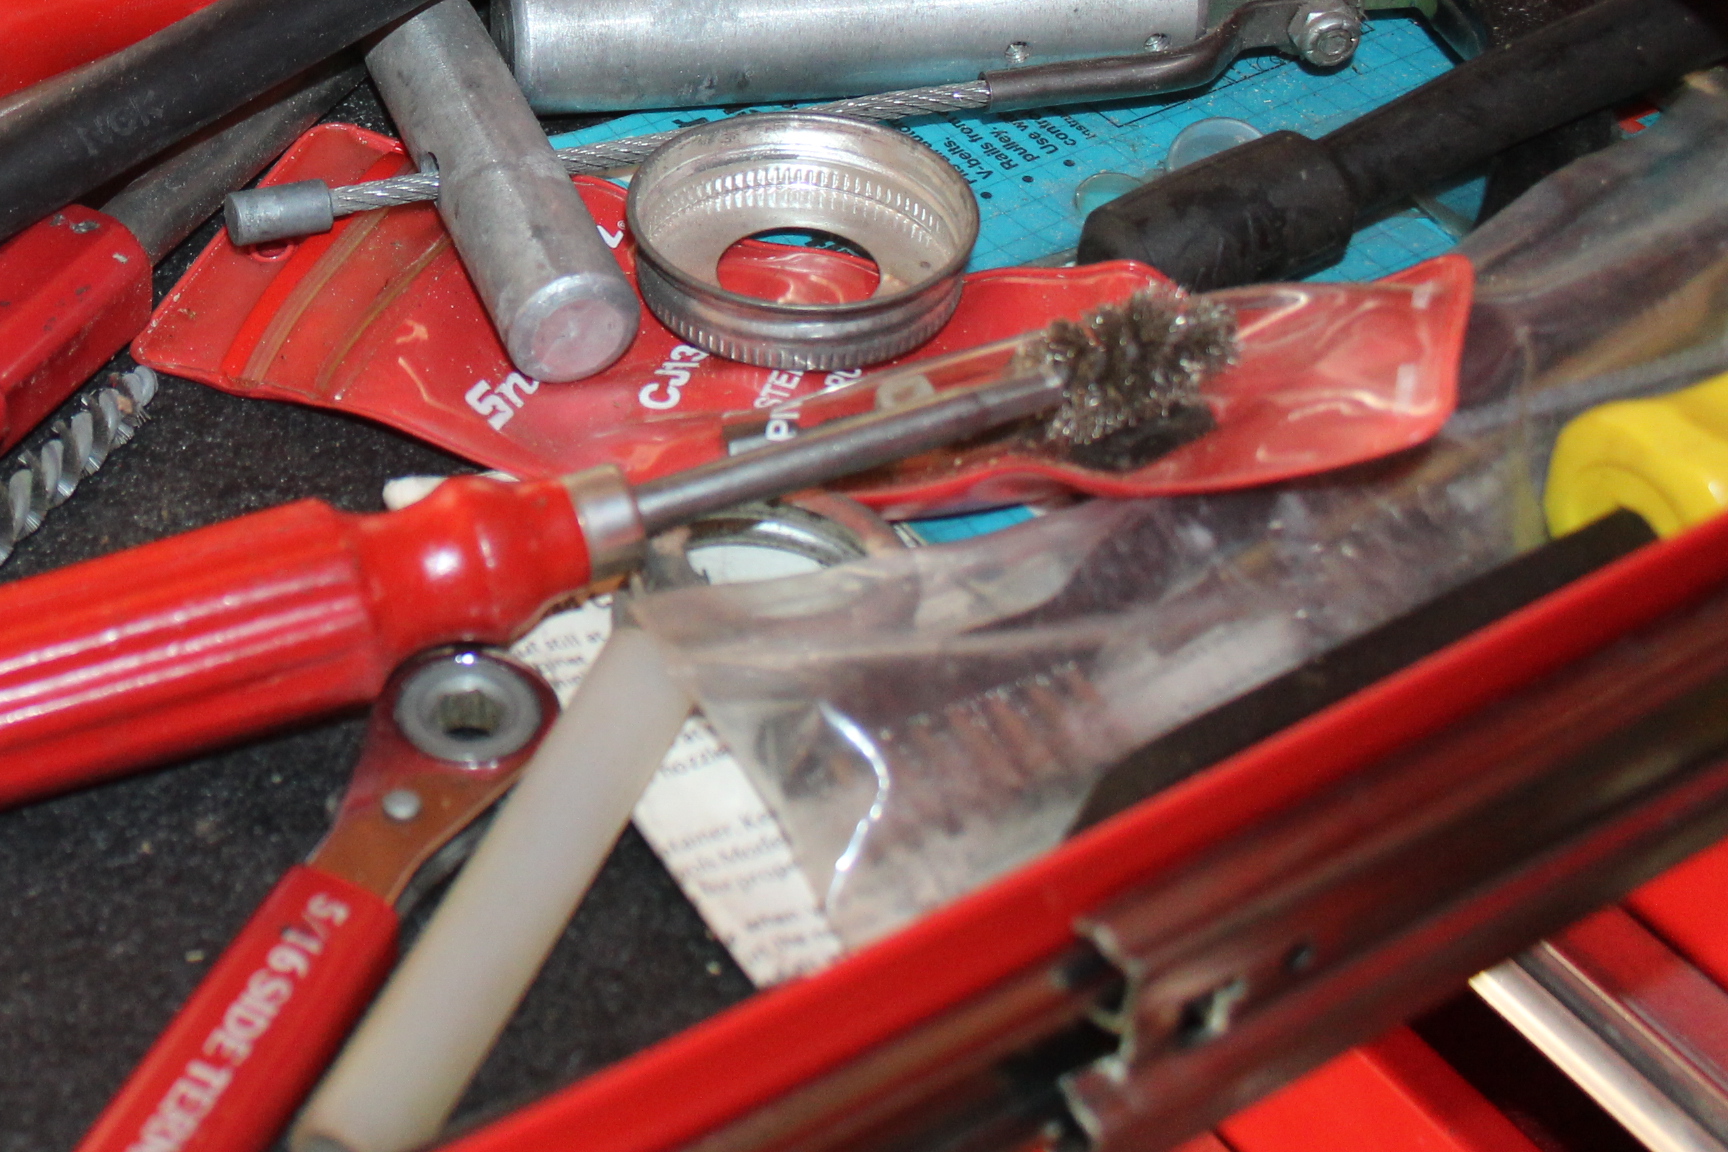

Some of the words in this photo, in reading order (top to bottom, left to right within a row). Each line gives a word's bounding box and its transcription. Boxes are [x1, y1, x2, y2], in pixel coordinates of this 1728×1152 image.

[943, 135, 995, 181] V-belts.
[980, 141, 1020, 172] Rails
[988, 126, 1041, 163] pulley.
[1028, 131, 1060, 155] Use
[267, 892, 351, 980] 5/16
[201, 967, 294, 1068] SIDE
